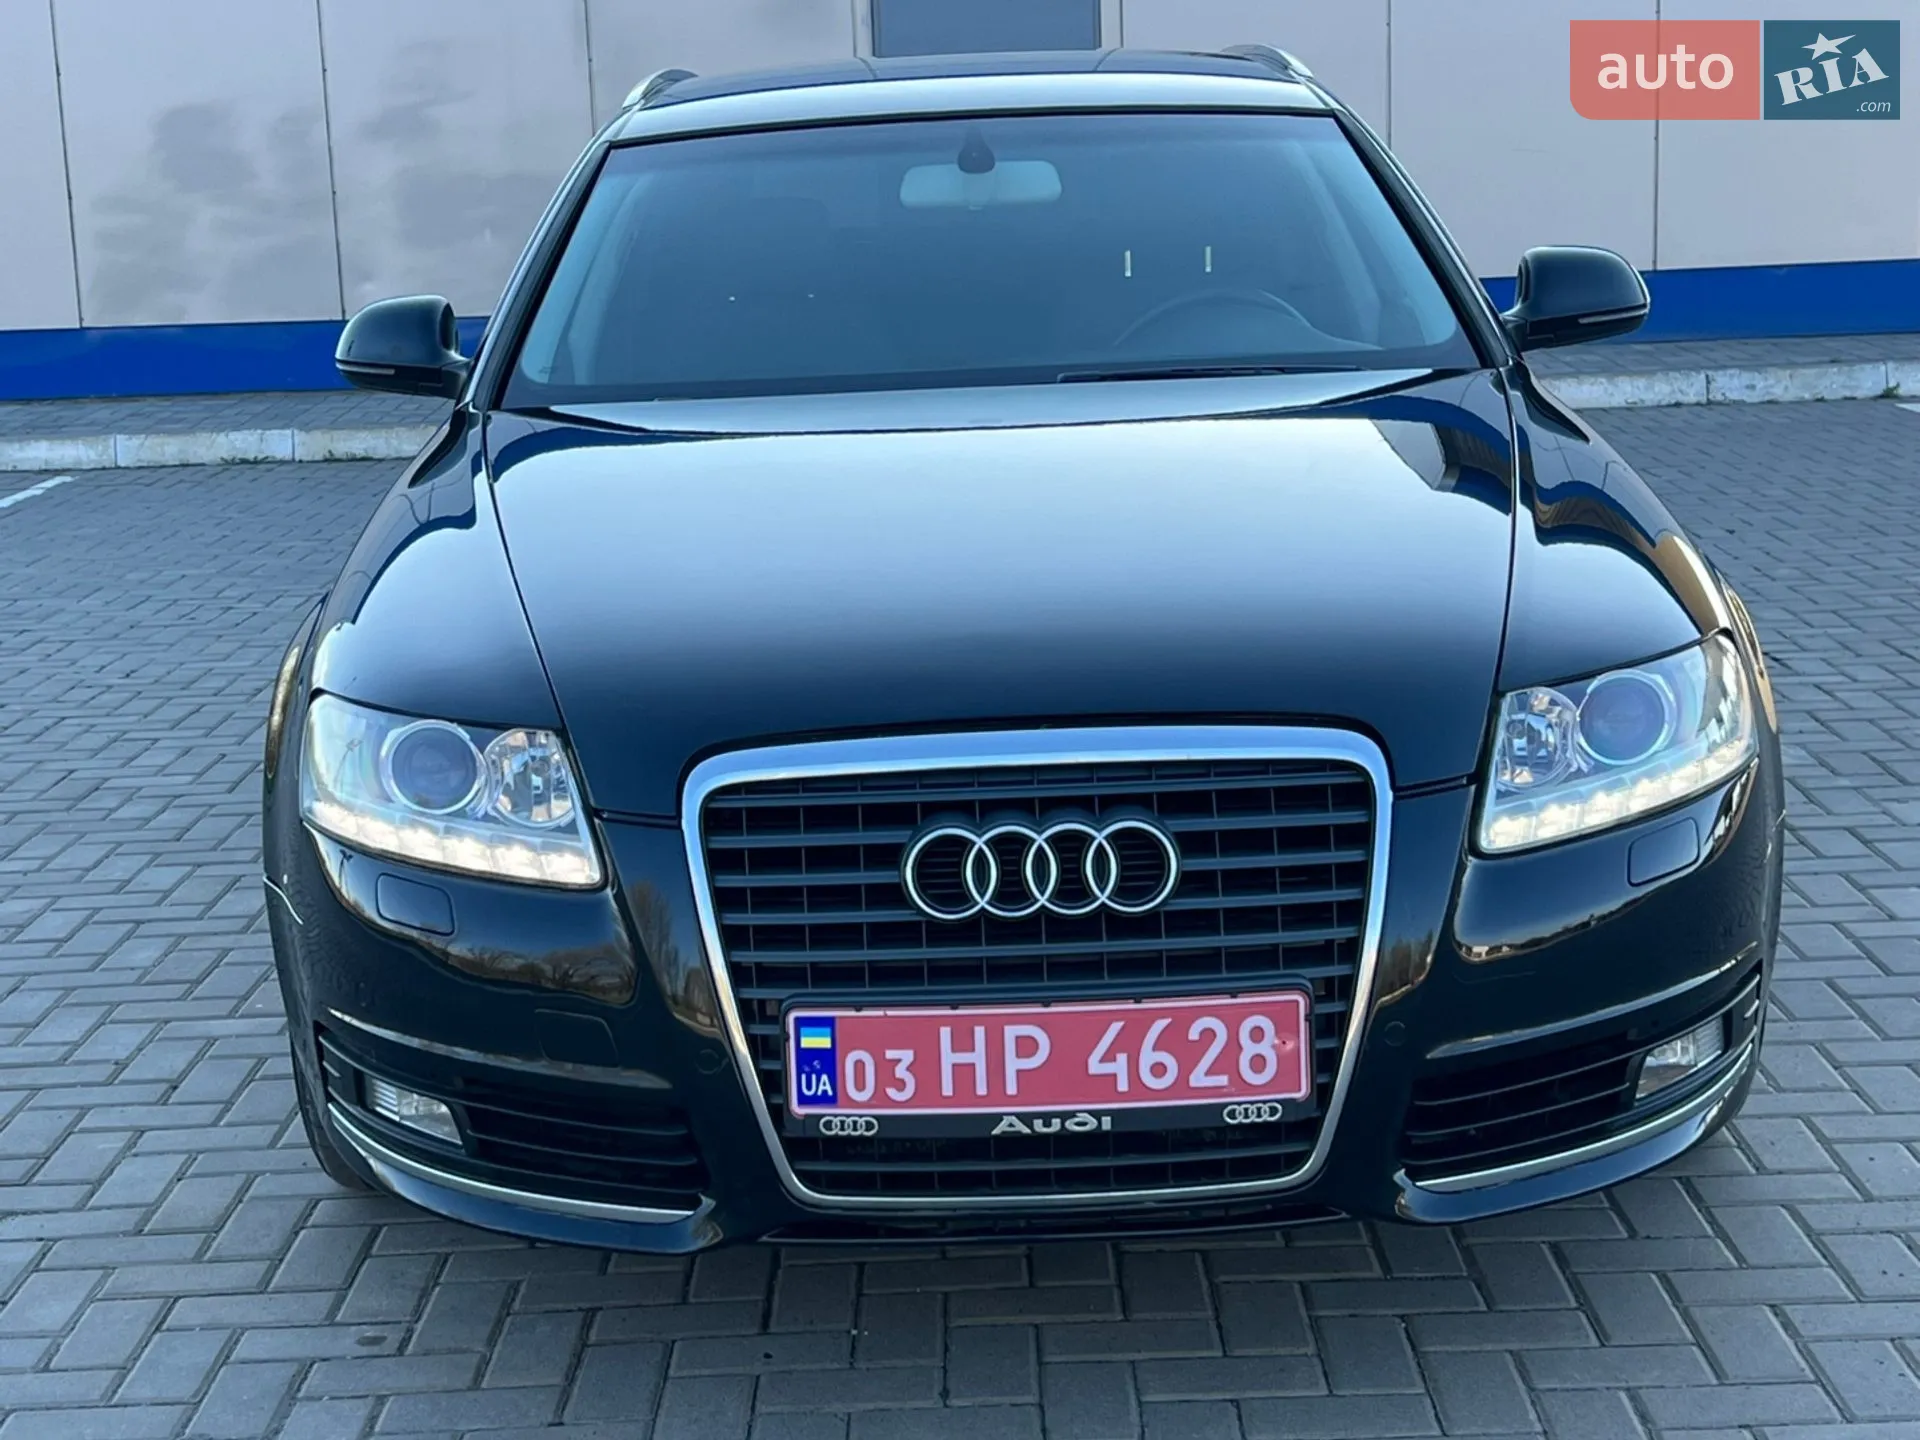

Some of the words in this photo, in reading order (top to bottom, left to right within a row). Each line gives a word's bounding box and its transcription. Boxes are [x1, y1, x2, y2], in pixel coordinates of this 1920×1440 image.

[844, 1050, 916, 1102] 03
[939, 1025, 1051, 1096] HP
[1087, 1014, 1278, 1092] 4628
[801, 1073, 833, 1097] UA
[991, 1112, 1112, 1136] Audi
